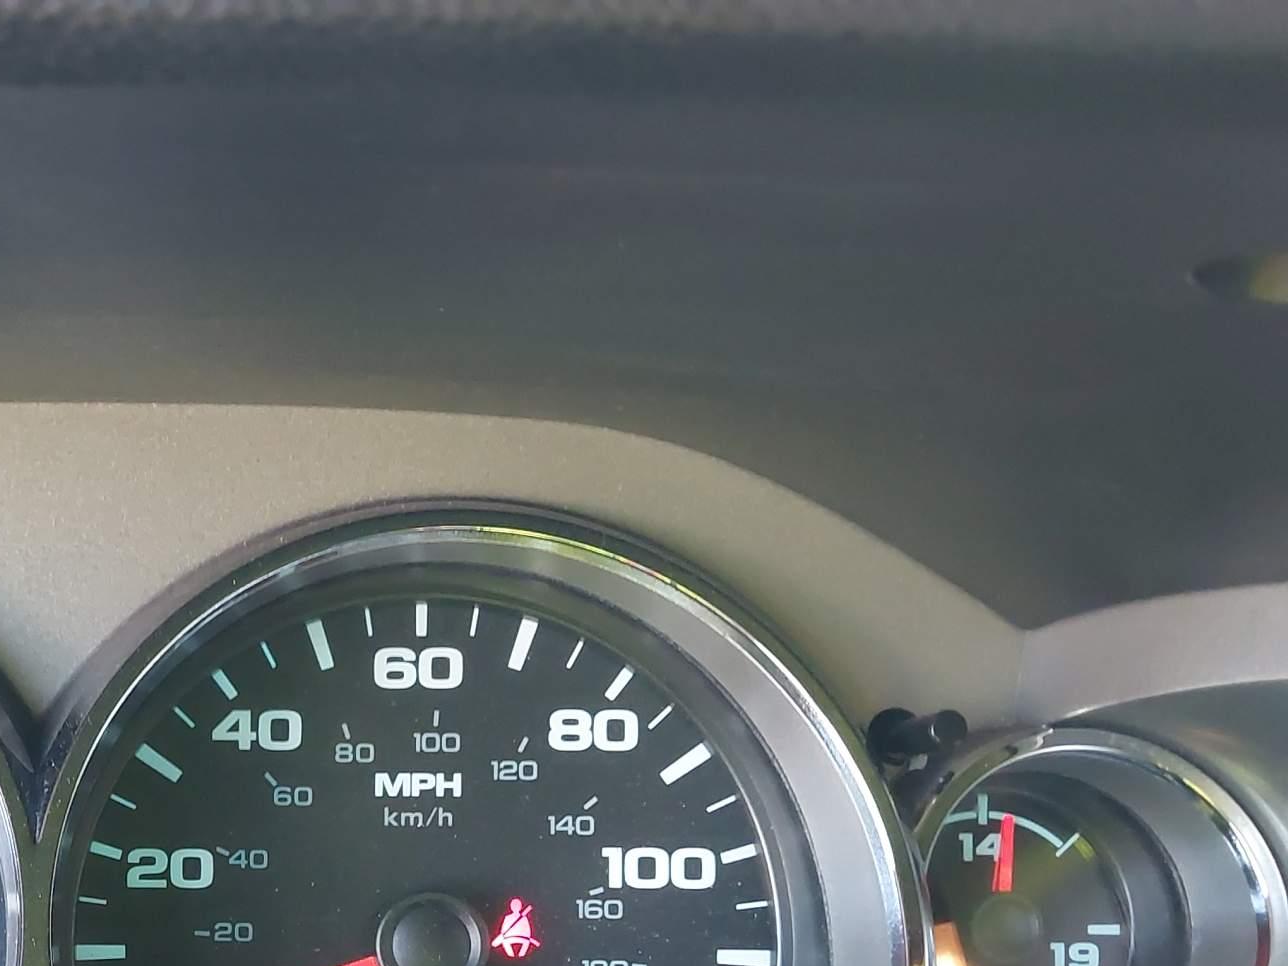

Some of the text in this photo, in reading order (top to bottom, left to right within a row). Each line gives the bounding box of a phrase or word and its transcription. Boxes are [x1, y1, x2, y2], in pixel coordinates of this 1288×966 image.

[373, 648, 463, 690] 60
[212, 710, 302, 751] 40
[548, 710, 638, 751] 80
[414, 732, 460, 753] 100
[335, 743, 375, 764] 80
[491, 761, 538, 781] 120
[375, 773, 462, 798] MPH
[273, 786, 313, 807] 60
[383, 806, 453, 827] km/h
[548, 815, 595, 836] 140
[958, 832, 1001, 862] 14
[126, 848, 213, 888] 20
[228, 849, 268, 869] 40
[601, 847, 715, 889] 100
[576, 899, 623, 920] 160
[214, 922, 253, 943] 20
